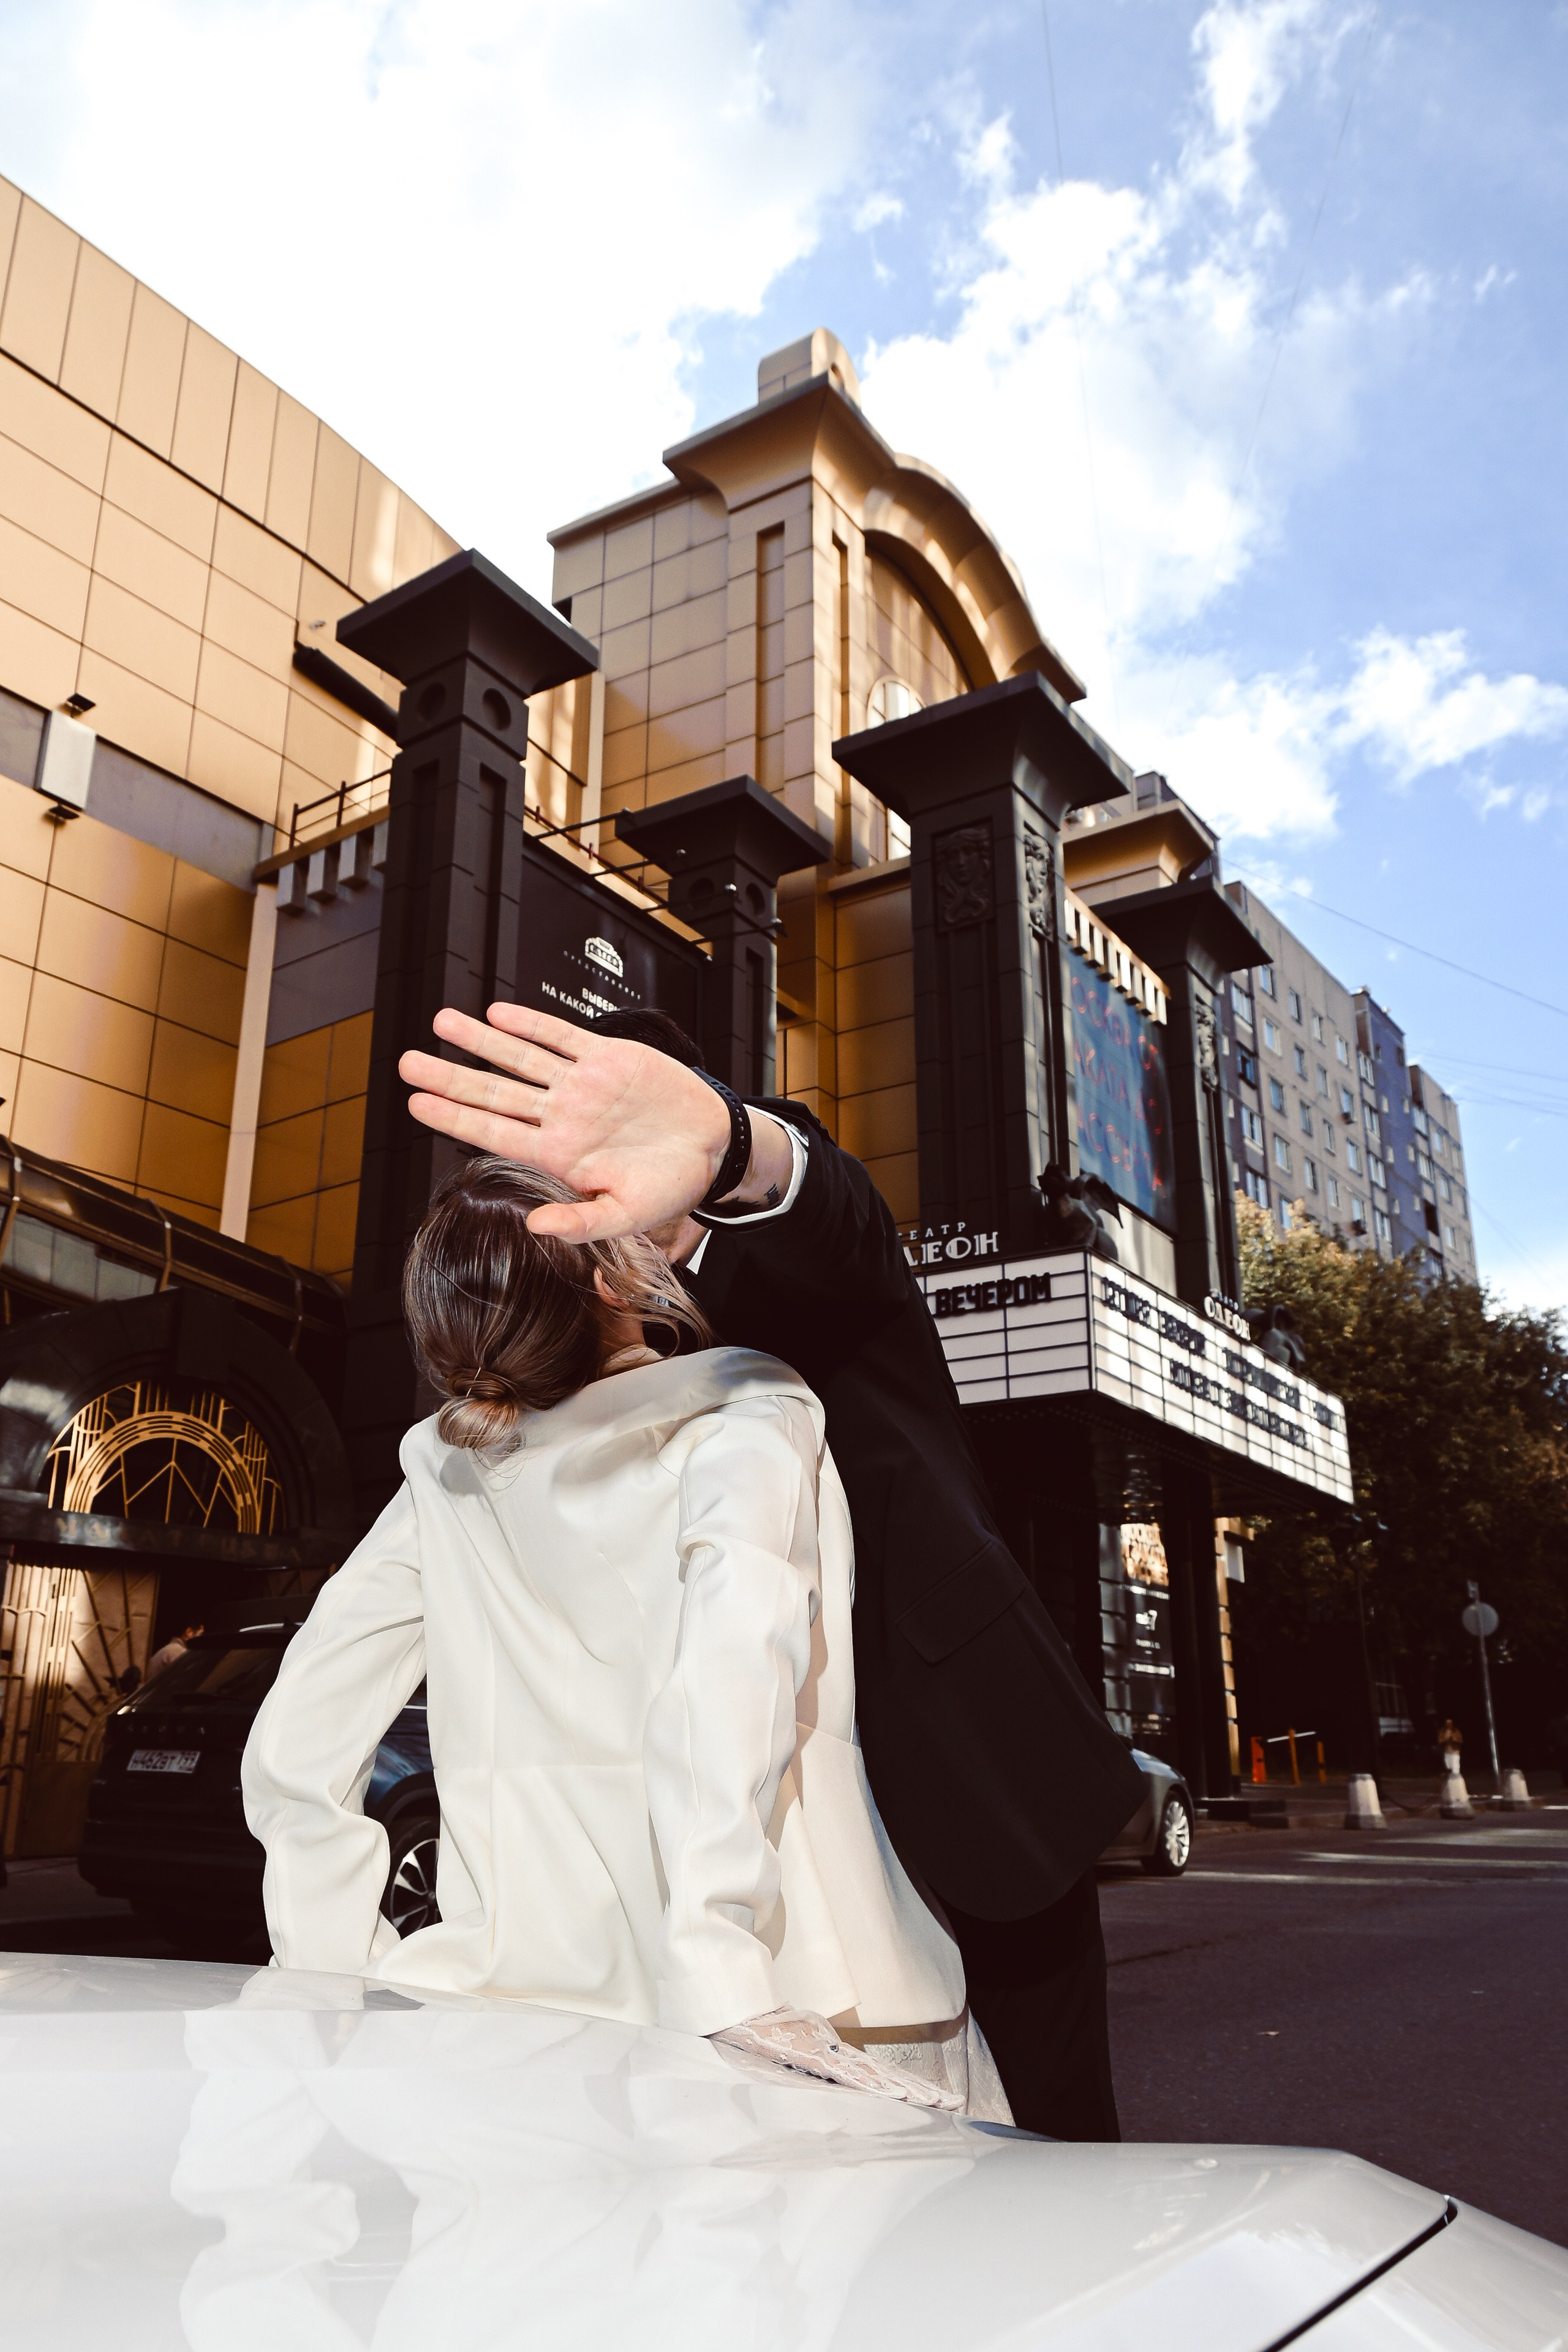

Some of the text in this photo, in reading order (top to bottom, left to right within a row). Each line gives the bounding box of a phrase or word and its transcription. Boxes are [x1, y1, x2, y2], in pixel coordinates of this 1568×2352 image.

[542, 981, 594, 1019] НА КАКОЙ
[898, 1222, 966, 1240] ЕАТР
[933, 1272, 1052, 1317] ВЕЧЕРОМ
